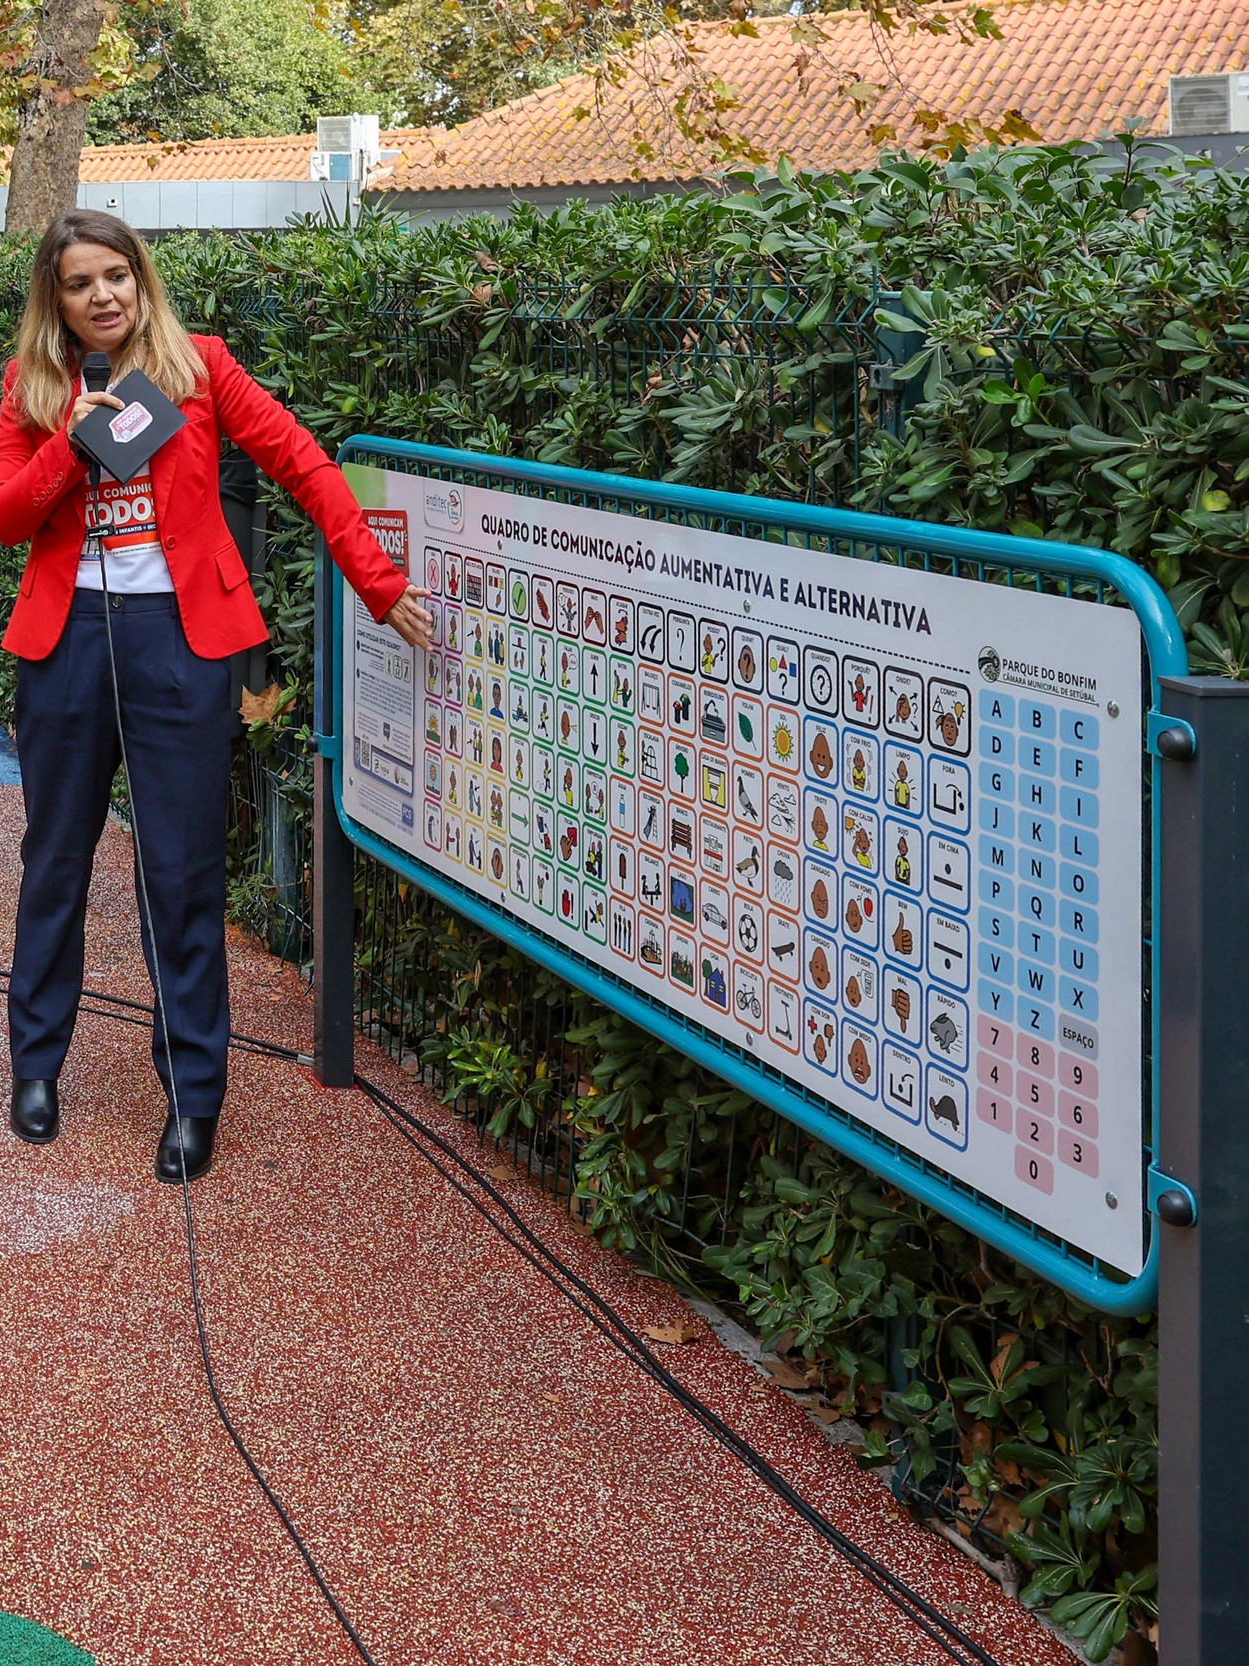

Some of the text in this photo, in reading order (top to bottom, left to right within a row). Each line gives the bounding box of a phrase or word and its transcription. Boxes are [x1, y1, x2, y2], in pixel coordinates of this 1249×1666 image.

[85, 497, 155, 528] TODO
[379, 516, 403, 528] COMUNICAM
[119, 526, 142, 534] INFANTIS
[482, 514, 932, 635] QUADRO DE COMUNICAÇÃO AUMENTATIVA E ALTERNATIVA
[673, 616, 690, 625] PERGUNTA
[811, 652, 831, 663] QUANDO?
[896, 676, 911, 685] ONDE?
[1003, 659, 1096, 690] PARQUE DO BONFIM
[940, 687, 958, 696] COMO?
[1003, 673, 1095, 702] CÂMARA MUNICIPAL DE SETÚBAL
[742, 701, 754, 711] FOLHA
[992, 700, 1083, 739] A B C
[816, 725, 826, 734] FELIZ
[850, 736, 871, 748] COM FRIO
[896, 751, 910, 760] LIMPO
[992, 736, 1083, 777] D E F
[741, 768, 755, 779] POMBO
[942, 765, 955, 774] FORA
[777, 782, 790, 792] VENTO
[992, 773, 1001, 791] G
[1032, 785, 1041, 804] H
[814, 795, 827, 805] TRISTE
[676, 807, 688, 816] BANCO
[848, 808, 874, 822] COM CALOR
[703, 819, 726, 833] RESTAURANTE
[898, 827, 909, 836] SUJO
[743, 834, 753, 845] PATO
[1033, 822, 1041, 842] K
[1075, 836, 1082, 856] L
[777, 849, 791, 860] CHUVA
[947, 845, 959, 855] CIMA
[678, 871, 687, 880] LAGO
[810, 864, 830, 877] ZANGADO
[992, 847, 1084, 893] M N O
[708, 885, 720, 896] CARRO
[850, 880, 872, 895] COM FOME
[744, 902, 754, 912] BOLA
[898, 900, 908, 910] BEM
[993, 881, 1084, 932] P Q R
[778, 918, 790, 929] SKATE
[937, 918, 960, 933] EM BAIXO
[811, 934, 830, 949] CANSADO
[992, 918, 1083, 969] S T U
[710, 952, 720, 961] CASA
[850, 954, 870, 968] COM SEDE
[740, 968, 758, 981] BICICLETA
[897, 976, 907, 986] MAL
[991, 953, 1084, 1009] V W X
[937, 995, 955, 1009] RÁPIDO
[811, 1006, 830, 1020] COM DOR
[991, 992, 1094, 1049] Y Z ESPAÇO
[848, 1026, 871, 1043] COM MEDO
[893, 1050, 911, 1064] DENTRO
[991, 1027, 1082, 1085] 7 8 9
[939, 1074, 955, 1088] LENTO
[991, 1066, 1082, 1124] 4 5 6
[991, 1102, 1082, 1163] 1 2 3
[1030, 1160, 1038, 1180] 0
